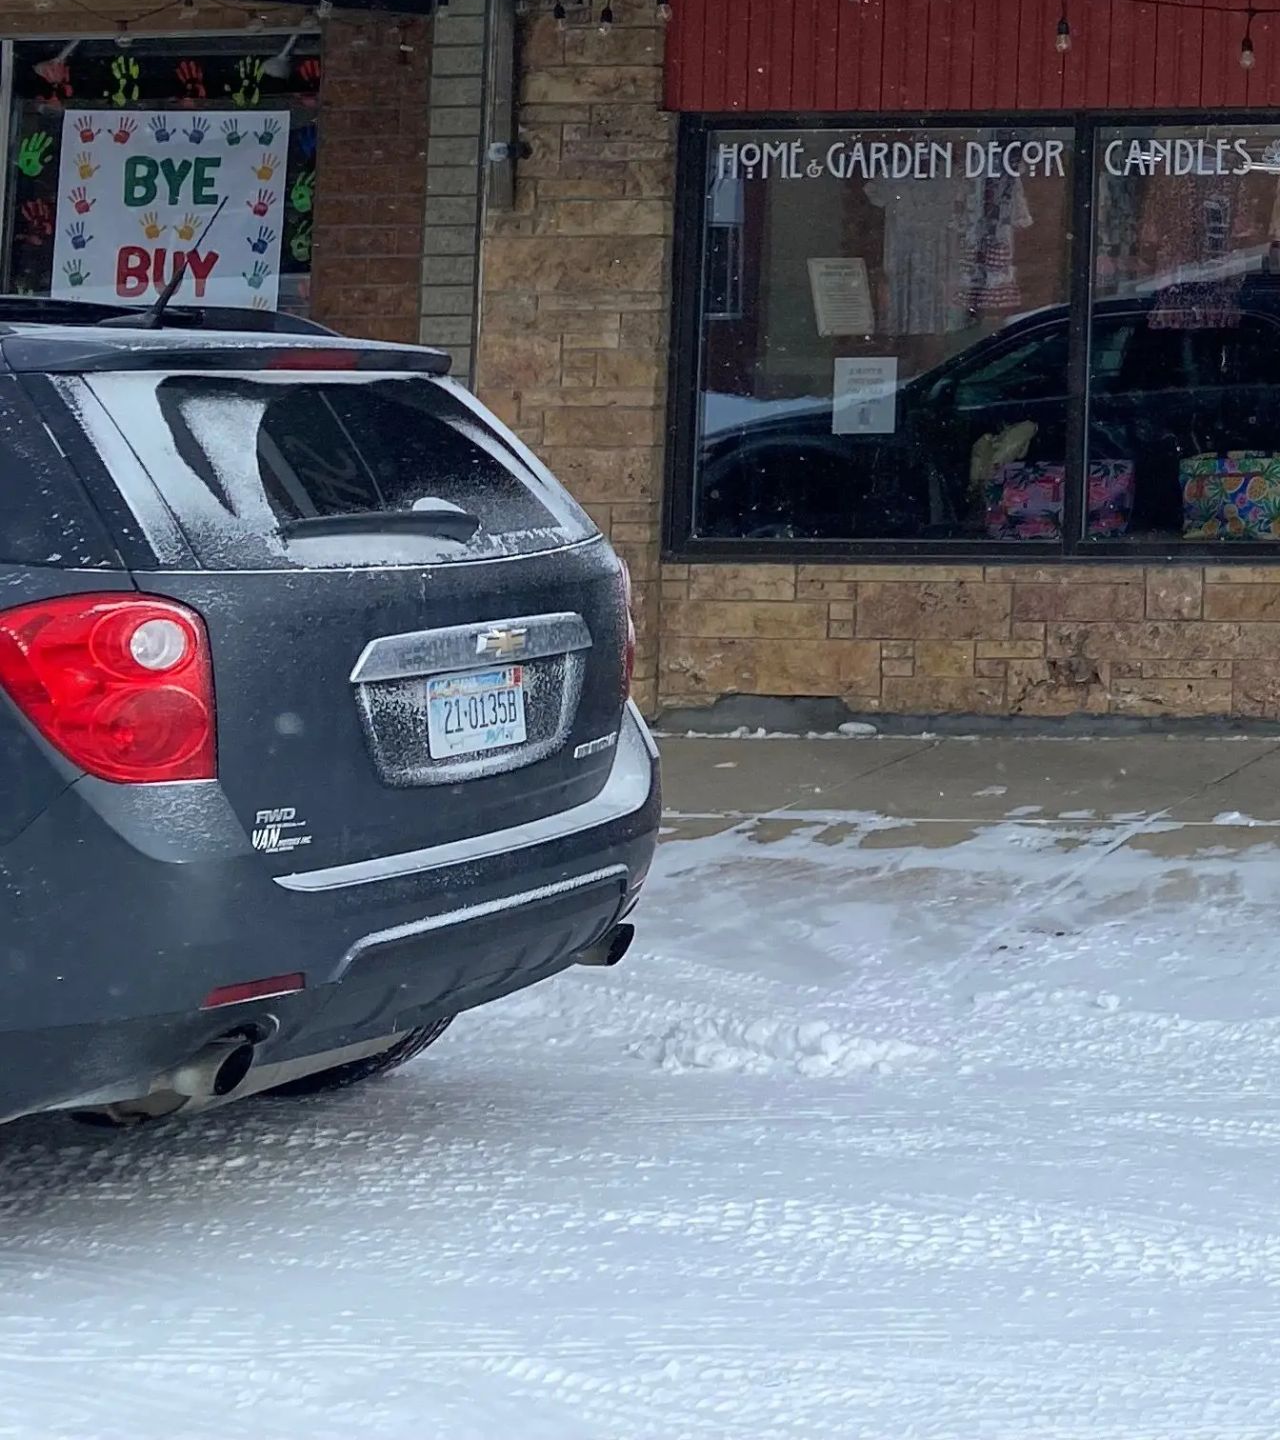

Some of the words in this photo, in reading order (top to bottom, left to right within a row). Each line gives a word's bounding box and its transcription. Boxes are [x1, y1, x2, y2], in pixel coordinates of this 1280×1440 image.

[718, 138, 804, 179] HOME
[826, 140, 953, 179] GARDEN
[965, 139, 1066, 178] DECOR
[1104, 138, 1252, 176] CANDLES
[124, 155, 222, 208] BYE
[115, 244, 220, 299] BUY
